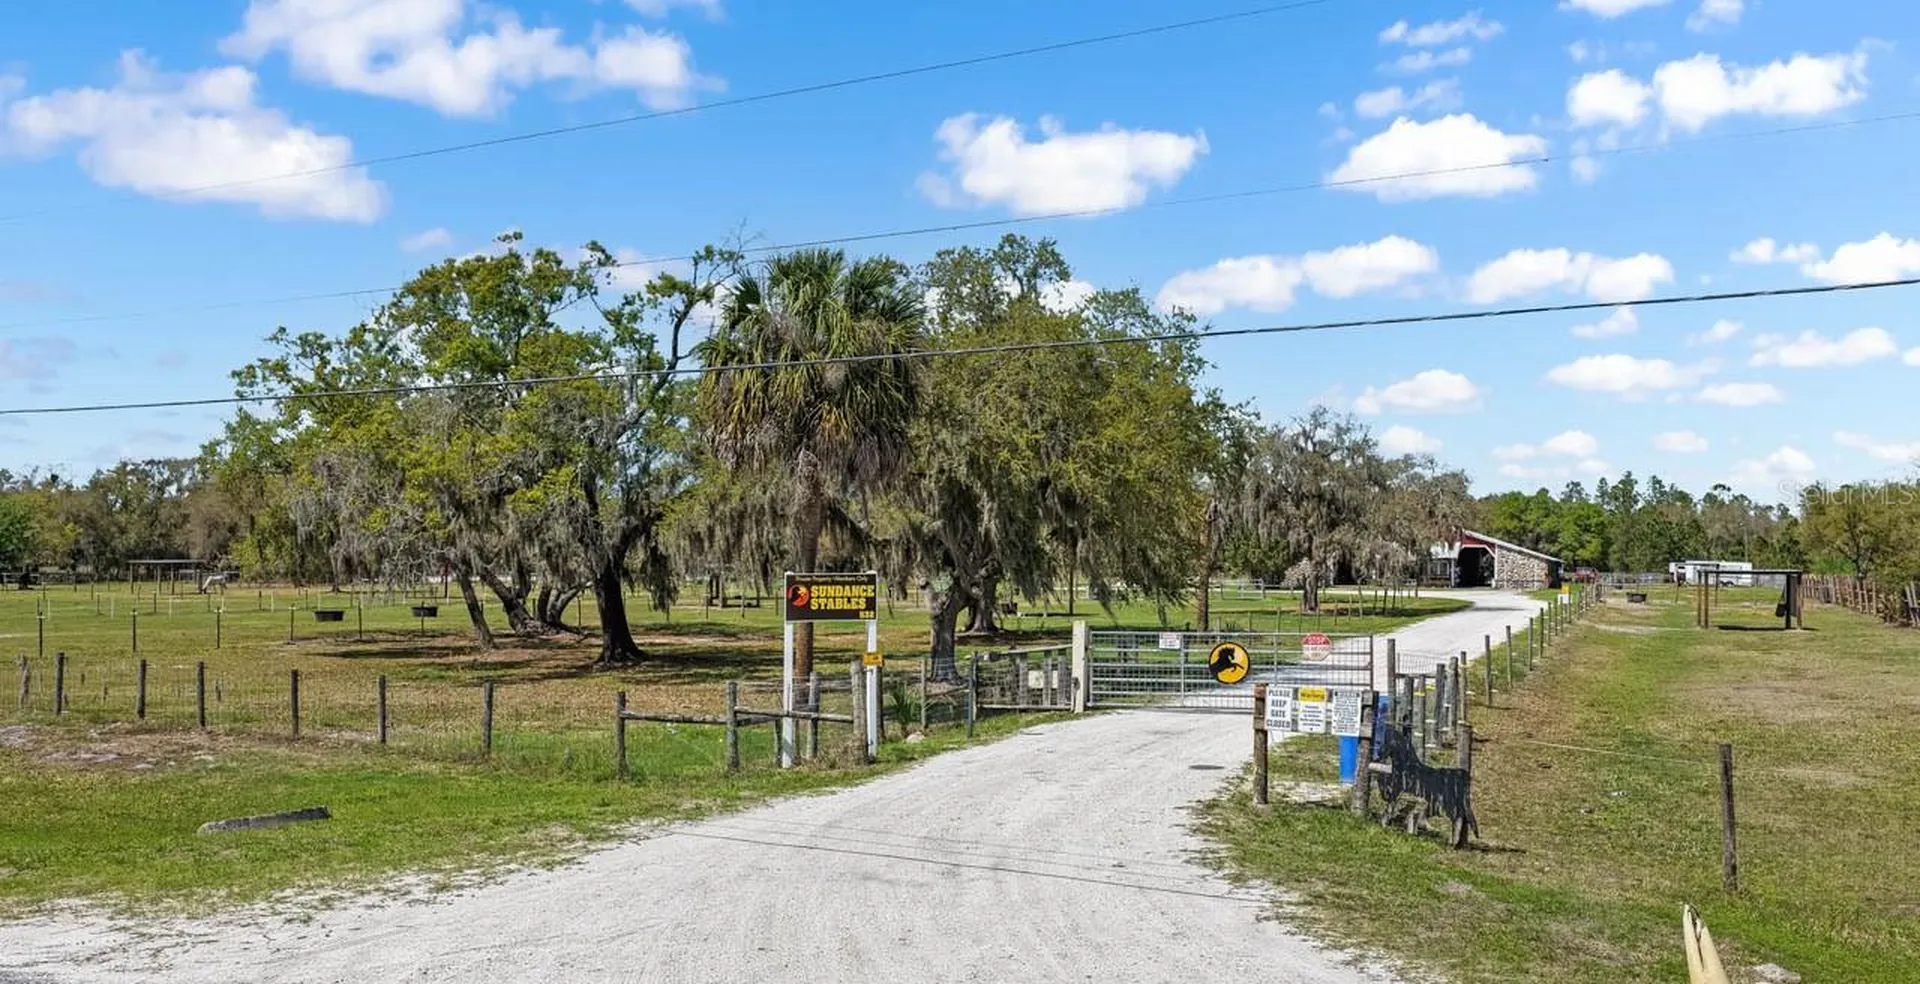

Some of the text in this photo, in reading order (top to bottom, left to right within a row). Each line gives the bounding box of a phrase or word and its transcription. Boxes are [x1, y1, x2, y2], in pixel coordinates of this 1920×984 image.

[810, 585, 875, 598] SUNDANCE
[810, 598, 866, 610] STABLES
[1271, 709, 1286, 717] GATE
[1266, 719, 1290, 728] CLOSED
